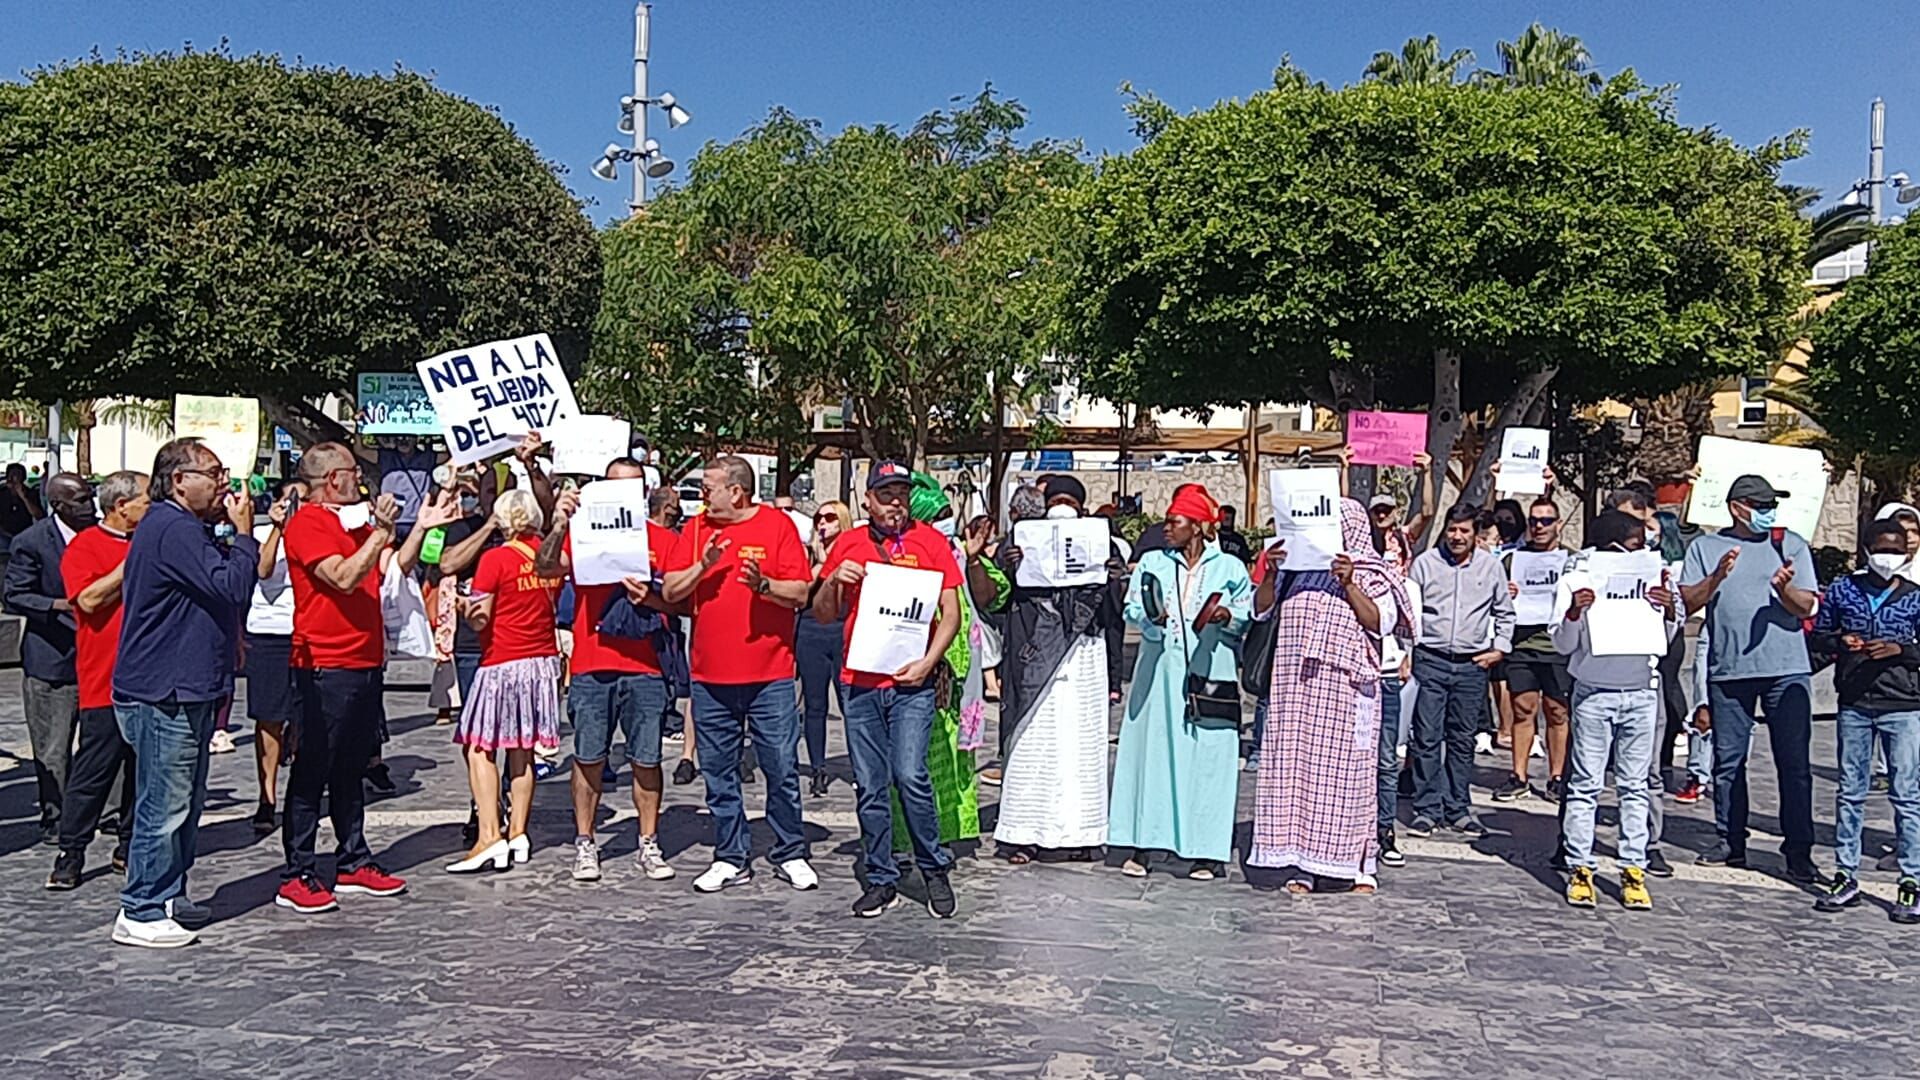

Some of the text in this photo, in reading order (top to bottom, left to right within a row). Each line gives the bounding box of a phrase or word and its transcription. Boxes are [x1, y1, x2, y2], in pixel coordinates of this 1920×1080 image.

[427, 340, 554, 393] NO A LA
[471, 373, 554, 412] SUBIDA
[451, 398, 566, 452] DEL 40%
[1355, 413, 1370, 429] NO
